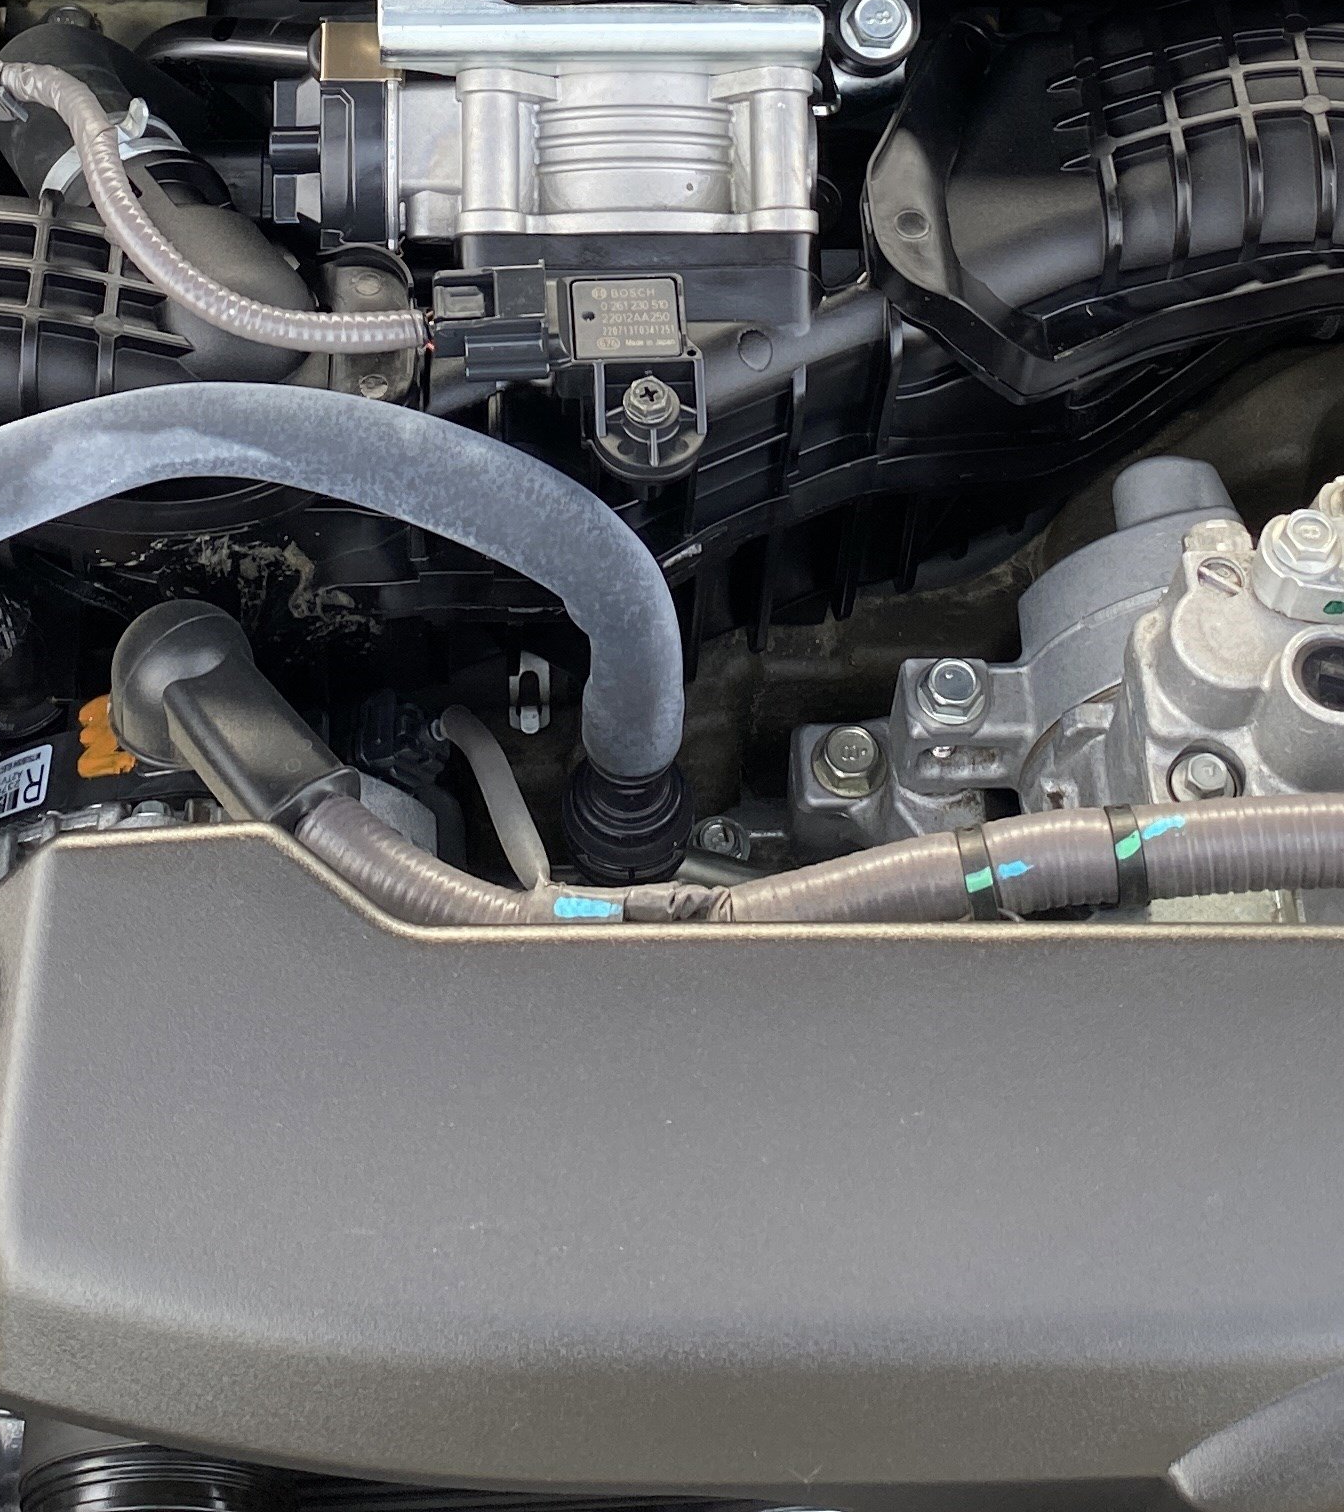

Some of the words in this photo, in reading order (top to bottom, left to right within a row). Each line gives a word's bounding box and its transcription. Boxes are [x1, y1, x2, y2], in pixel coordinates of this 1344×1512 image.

[610, 288, 656, 299] BOSCH
[610, 300, 629, 311] 261
[630, 300, 649, 311] 230
[23, 764, 45, 803] R
